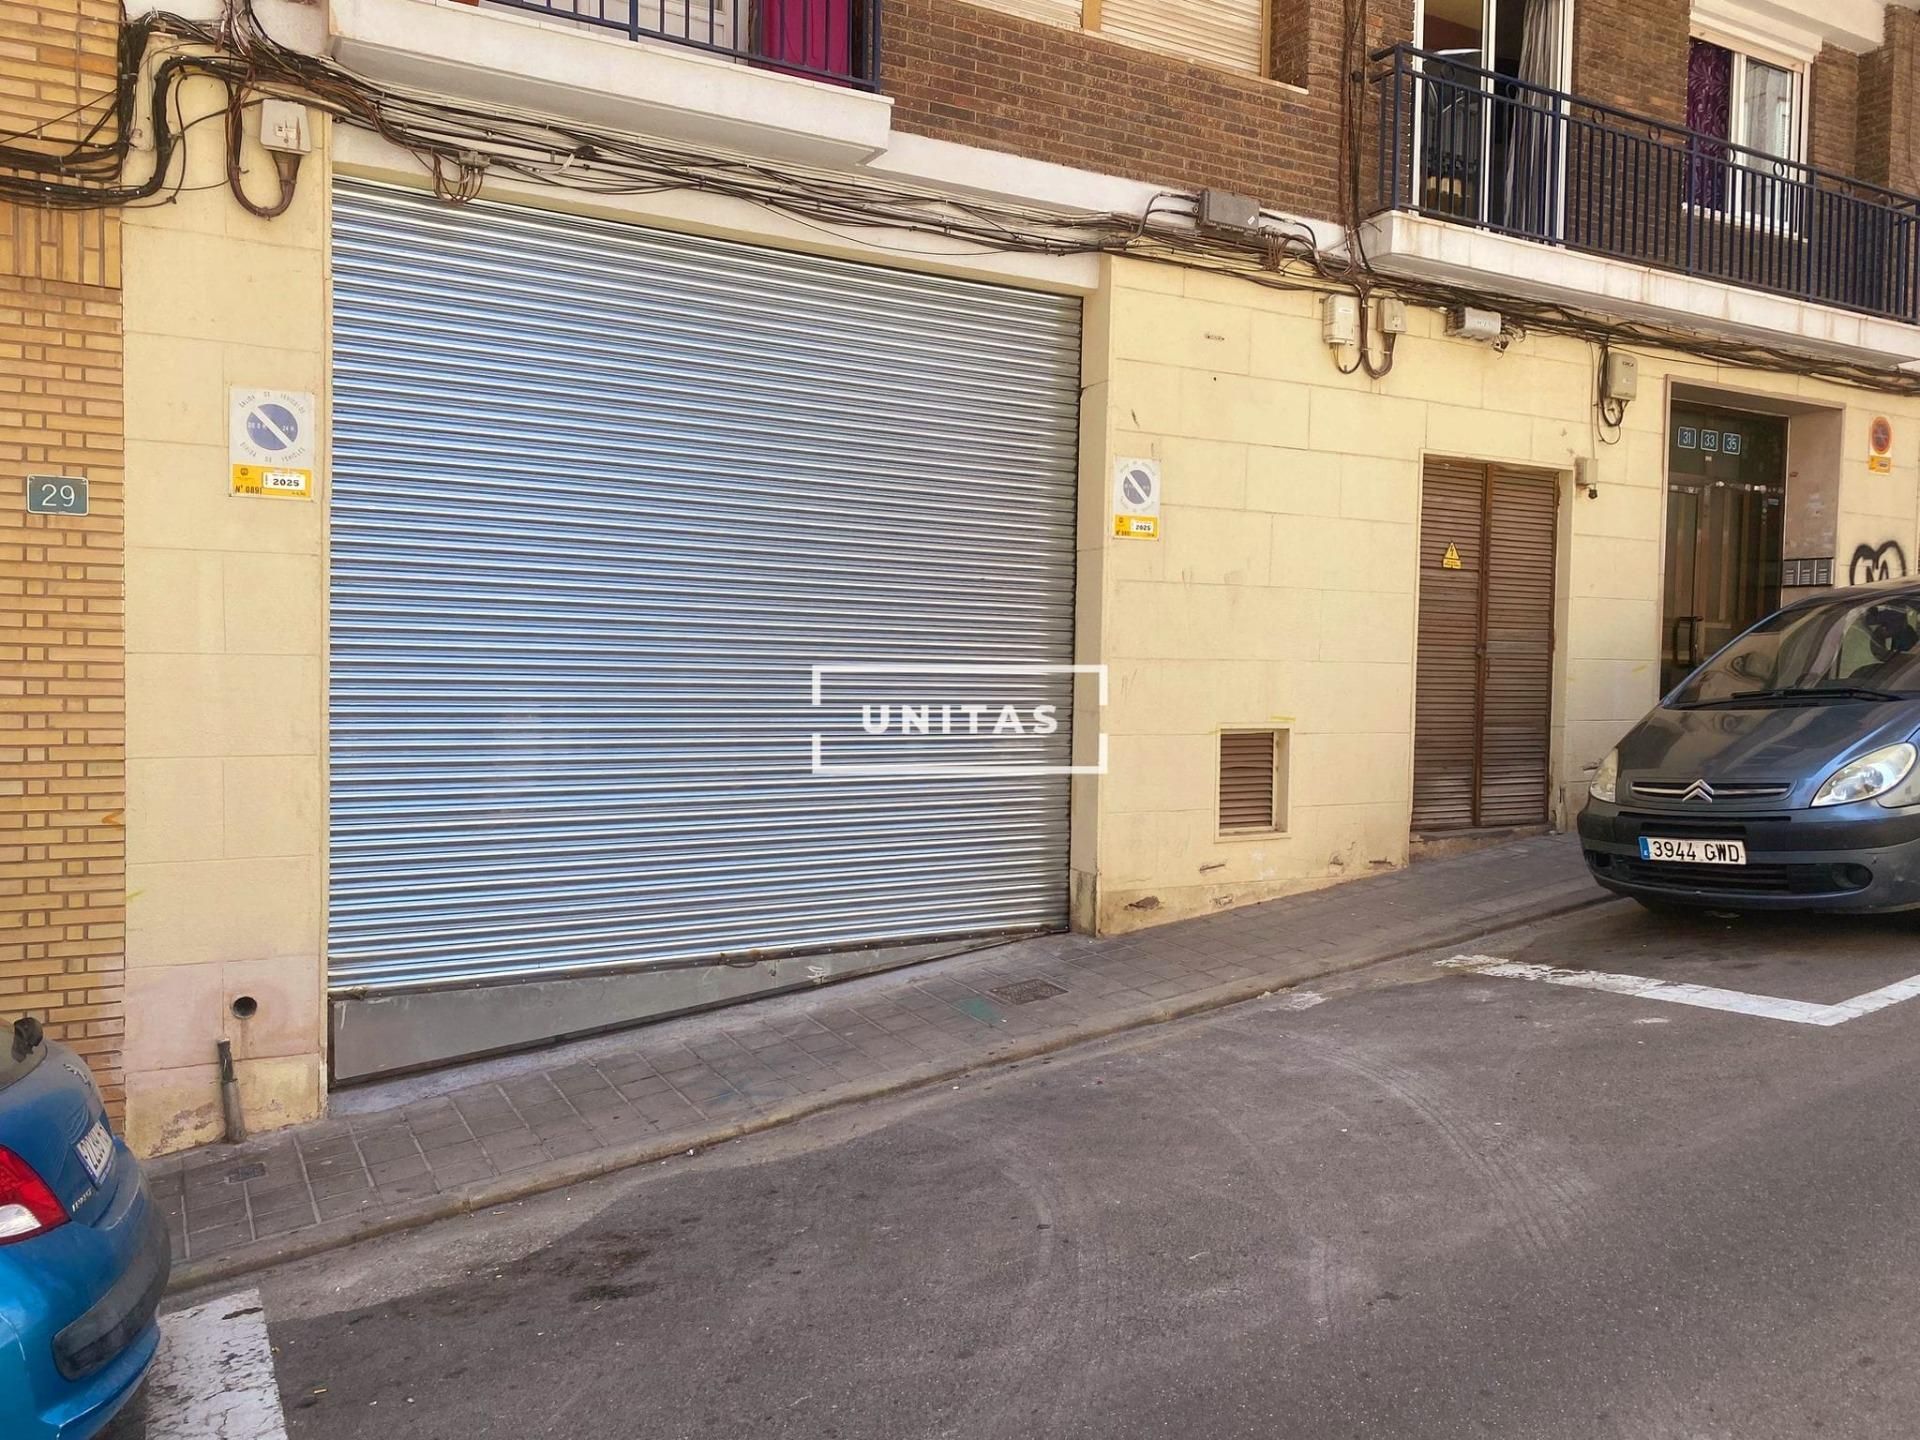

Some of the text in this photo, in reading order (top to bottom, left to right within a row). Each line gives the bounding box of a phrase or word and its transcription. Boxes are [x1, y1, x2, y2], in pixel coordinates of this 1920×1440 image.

[1683, 431, 1691, 445] 31
[1704, 433, 1715, 447] 33
[272, 478, 300, 487] 2025
[41, 483, 75, 507] 29
[1135, 524, 1152, 532] 2025
[1652, 840, 1740, 863] 3944 GWD
